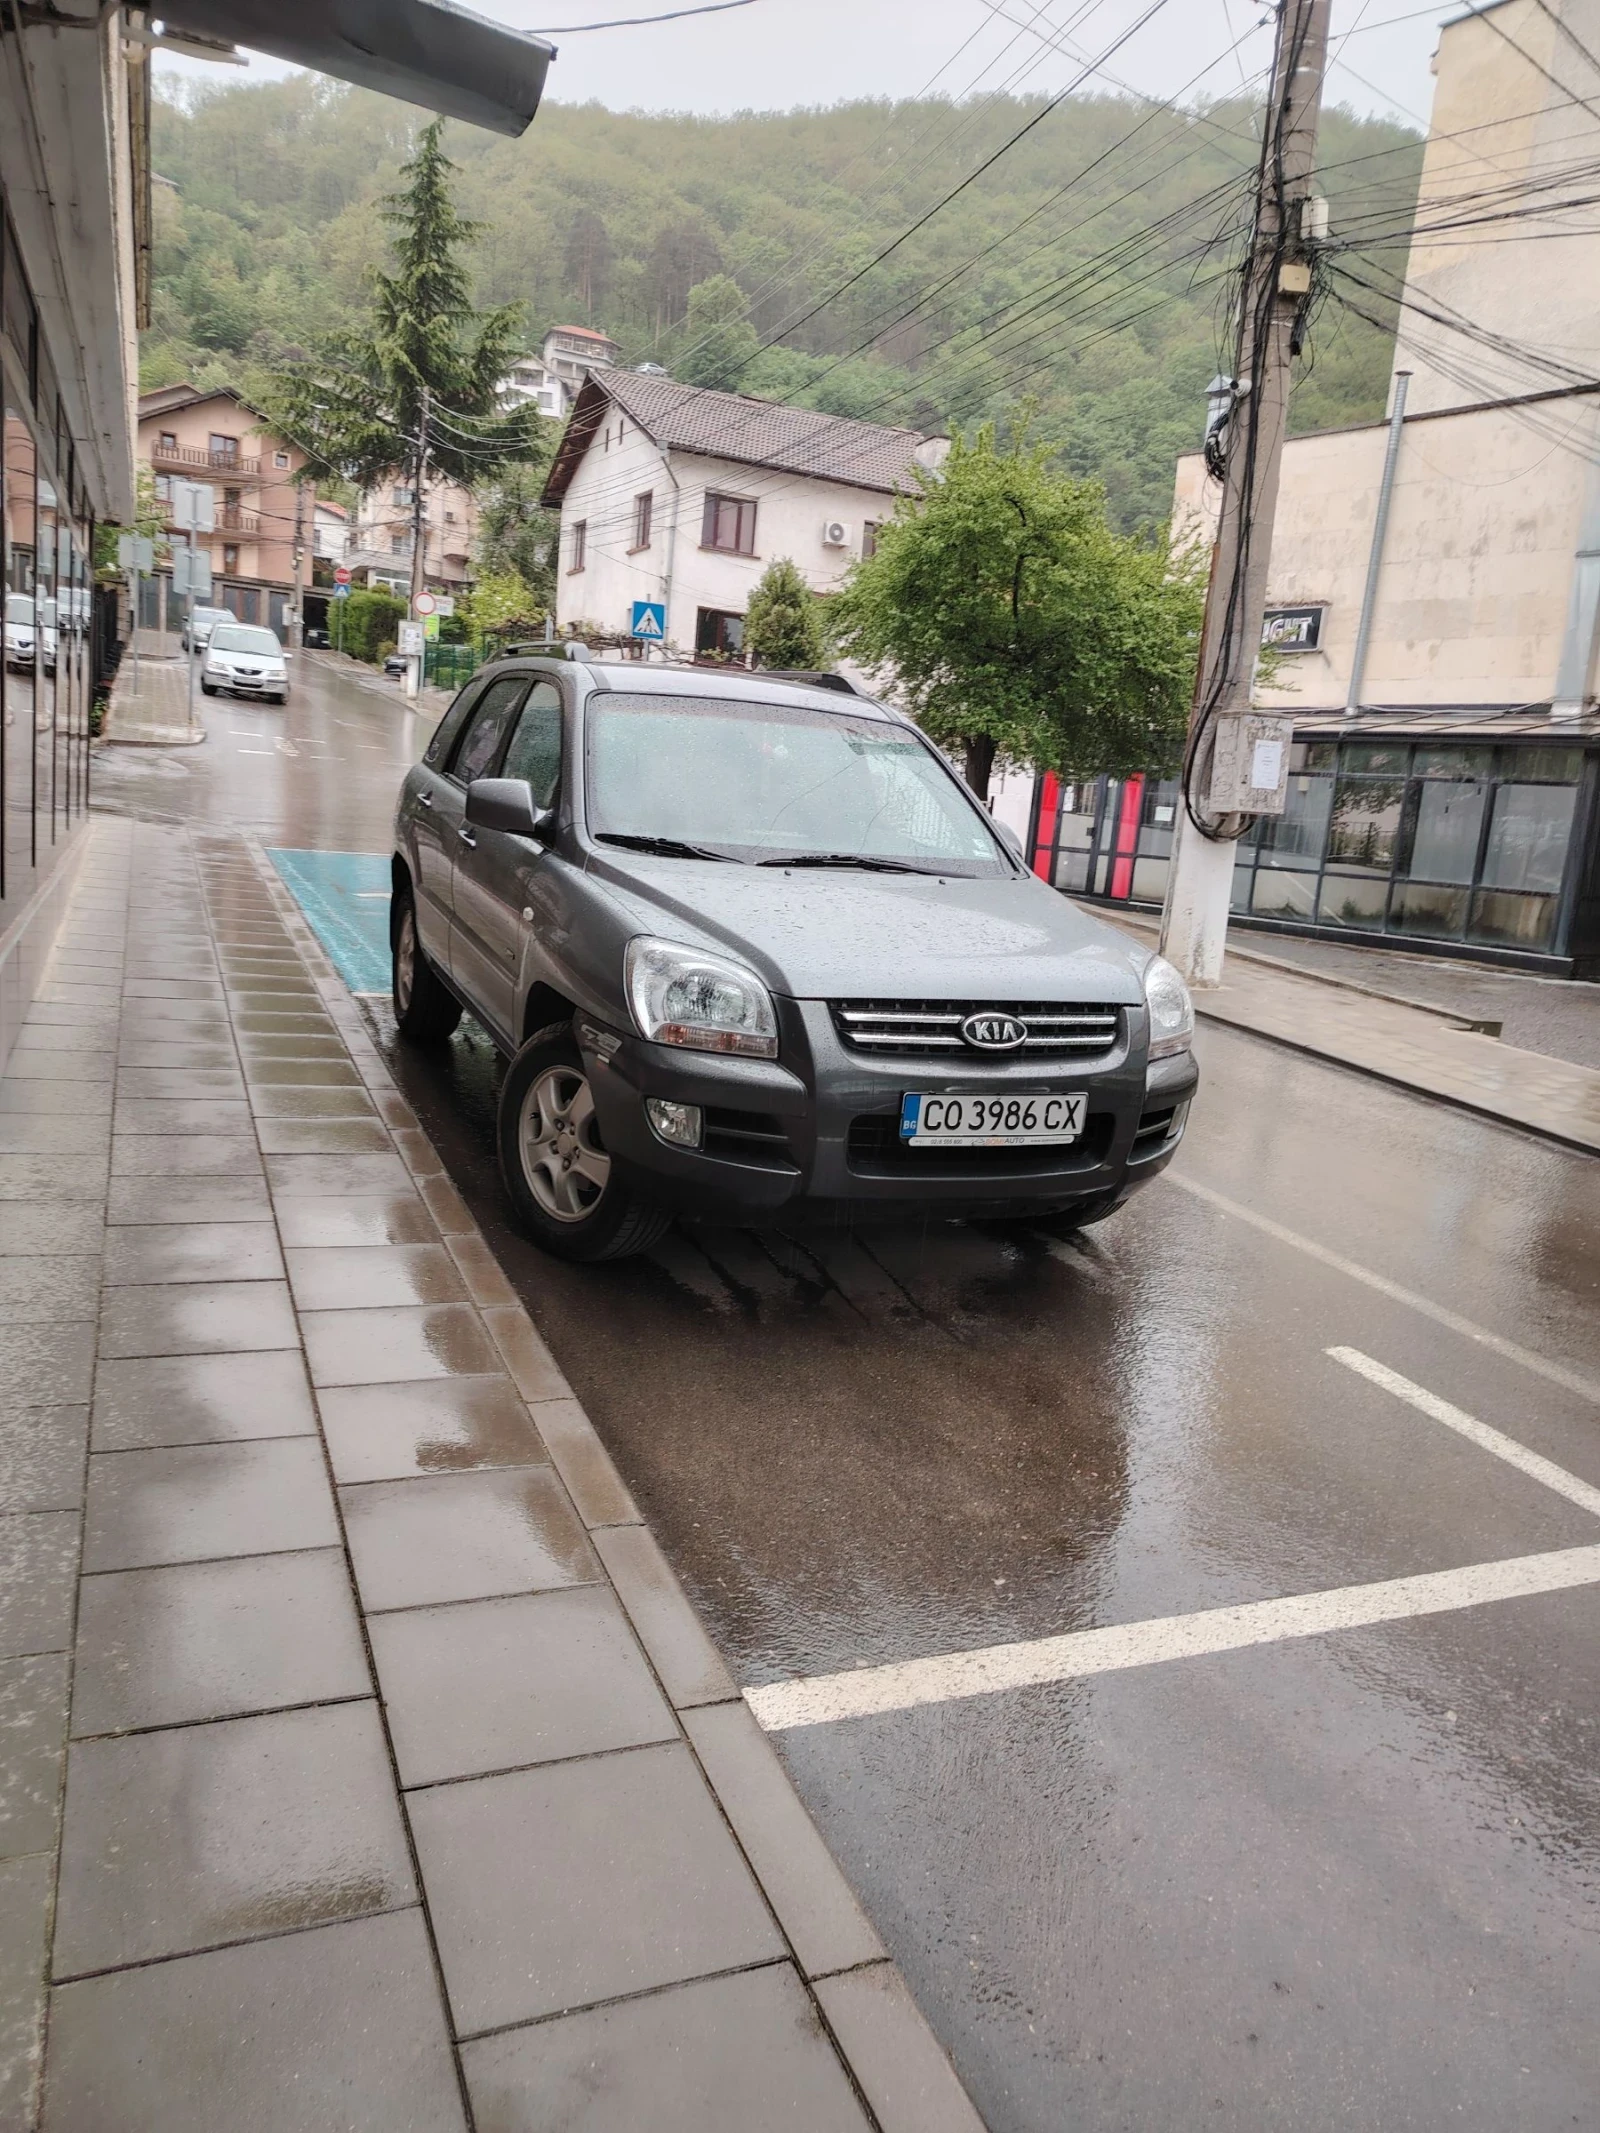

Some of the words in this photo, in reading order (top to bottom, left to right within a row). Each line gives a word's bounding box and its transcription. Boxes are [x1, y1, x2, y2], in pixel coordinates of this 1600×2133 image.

[1261, 615, 1313, 643] IGHT
[974, 1021, 1018, 1041] KIA
[903, 1120, 917, 1129] BG
[924, 1100, 962, 1131] CO
[968, 1100, 1036, 1131] 3986
[1044, 1100, 1081, 1130] CX
